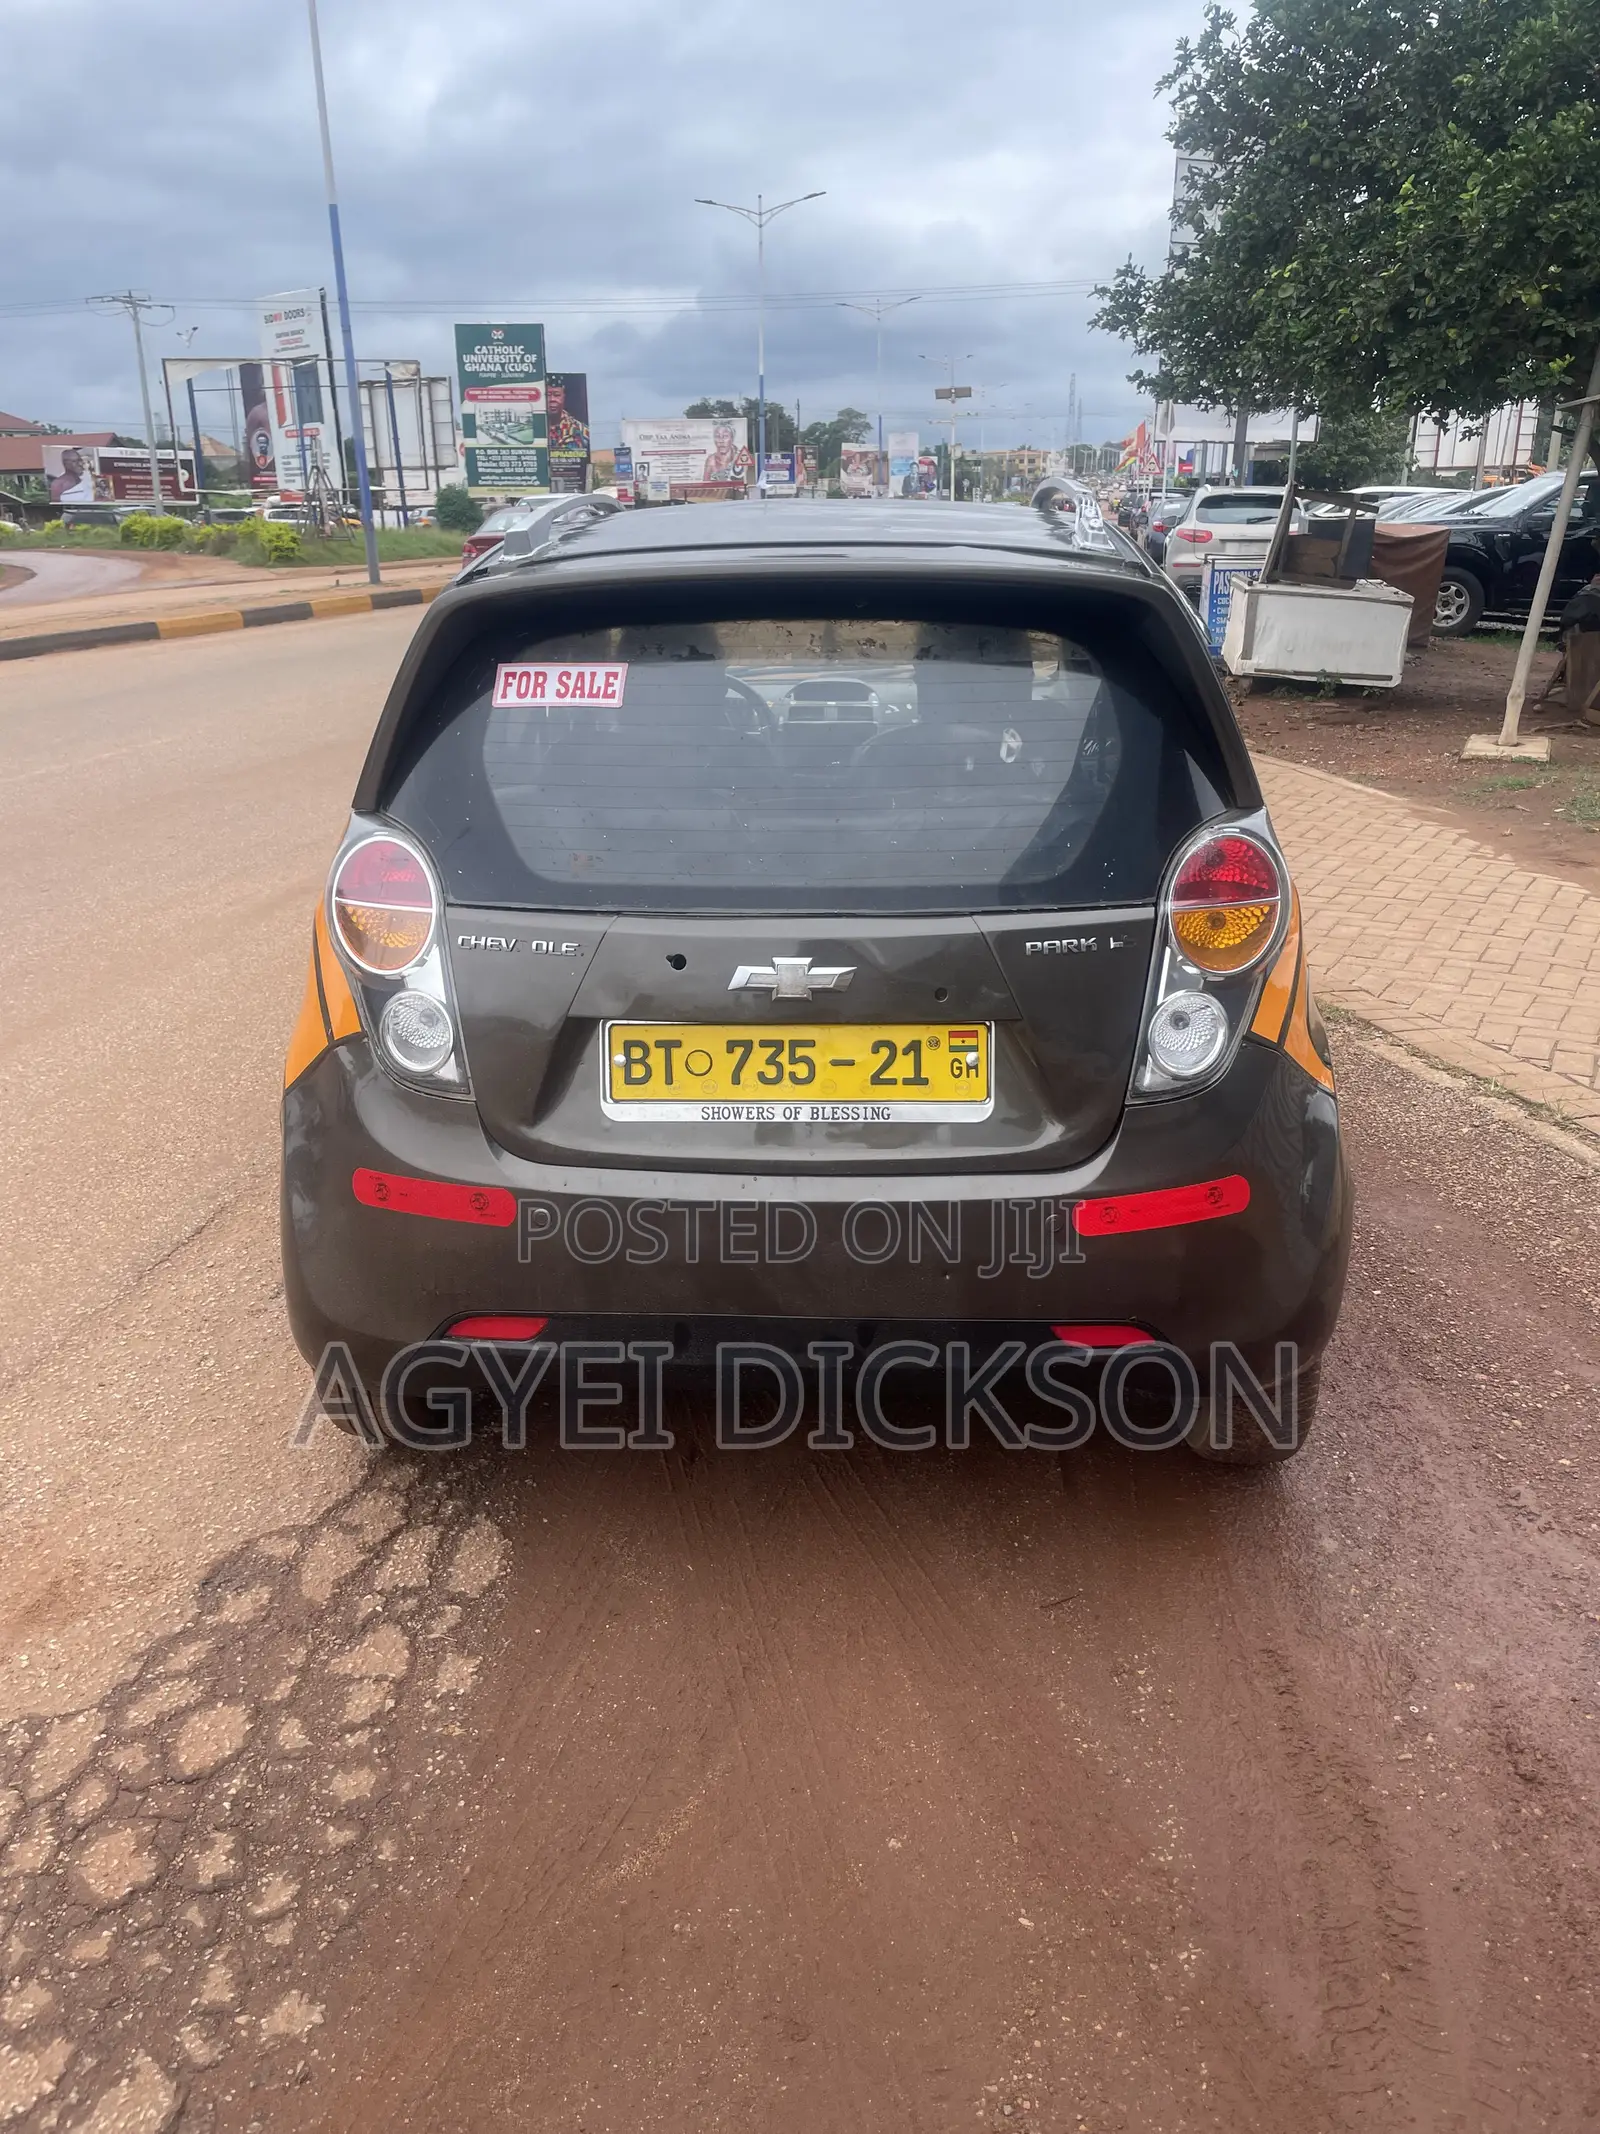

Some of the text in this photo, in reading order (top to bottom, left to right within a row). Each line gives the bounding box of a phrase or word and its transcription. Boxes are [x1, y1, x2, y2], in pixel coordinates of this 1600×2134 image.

[474, 345, 525, 355] CATHOLIC
[462, 354, 537, 363] UNIVERSITY OF
[464, 363, 502, 372] GHANA
[501, 671, 619, 699] FOR SALE
[623, 1040, 682, 1085] BT
[701, 1106, 891, 1121] SHOWERS OF BLESSING
